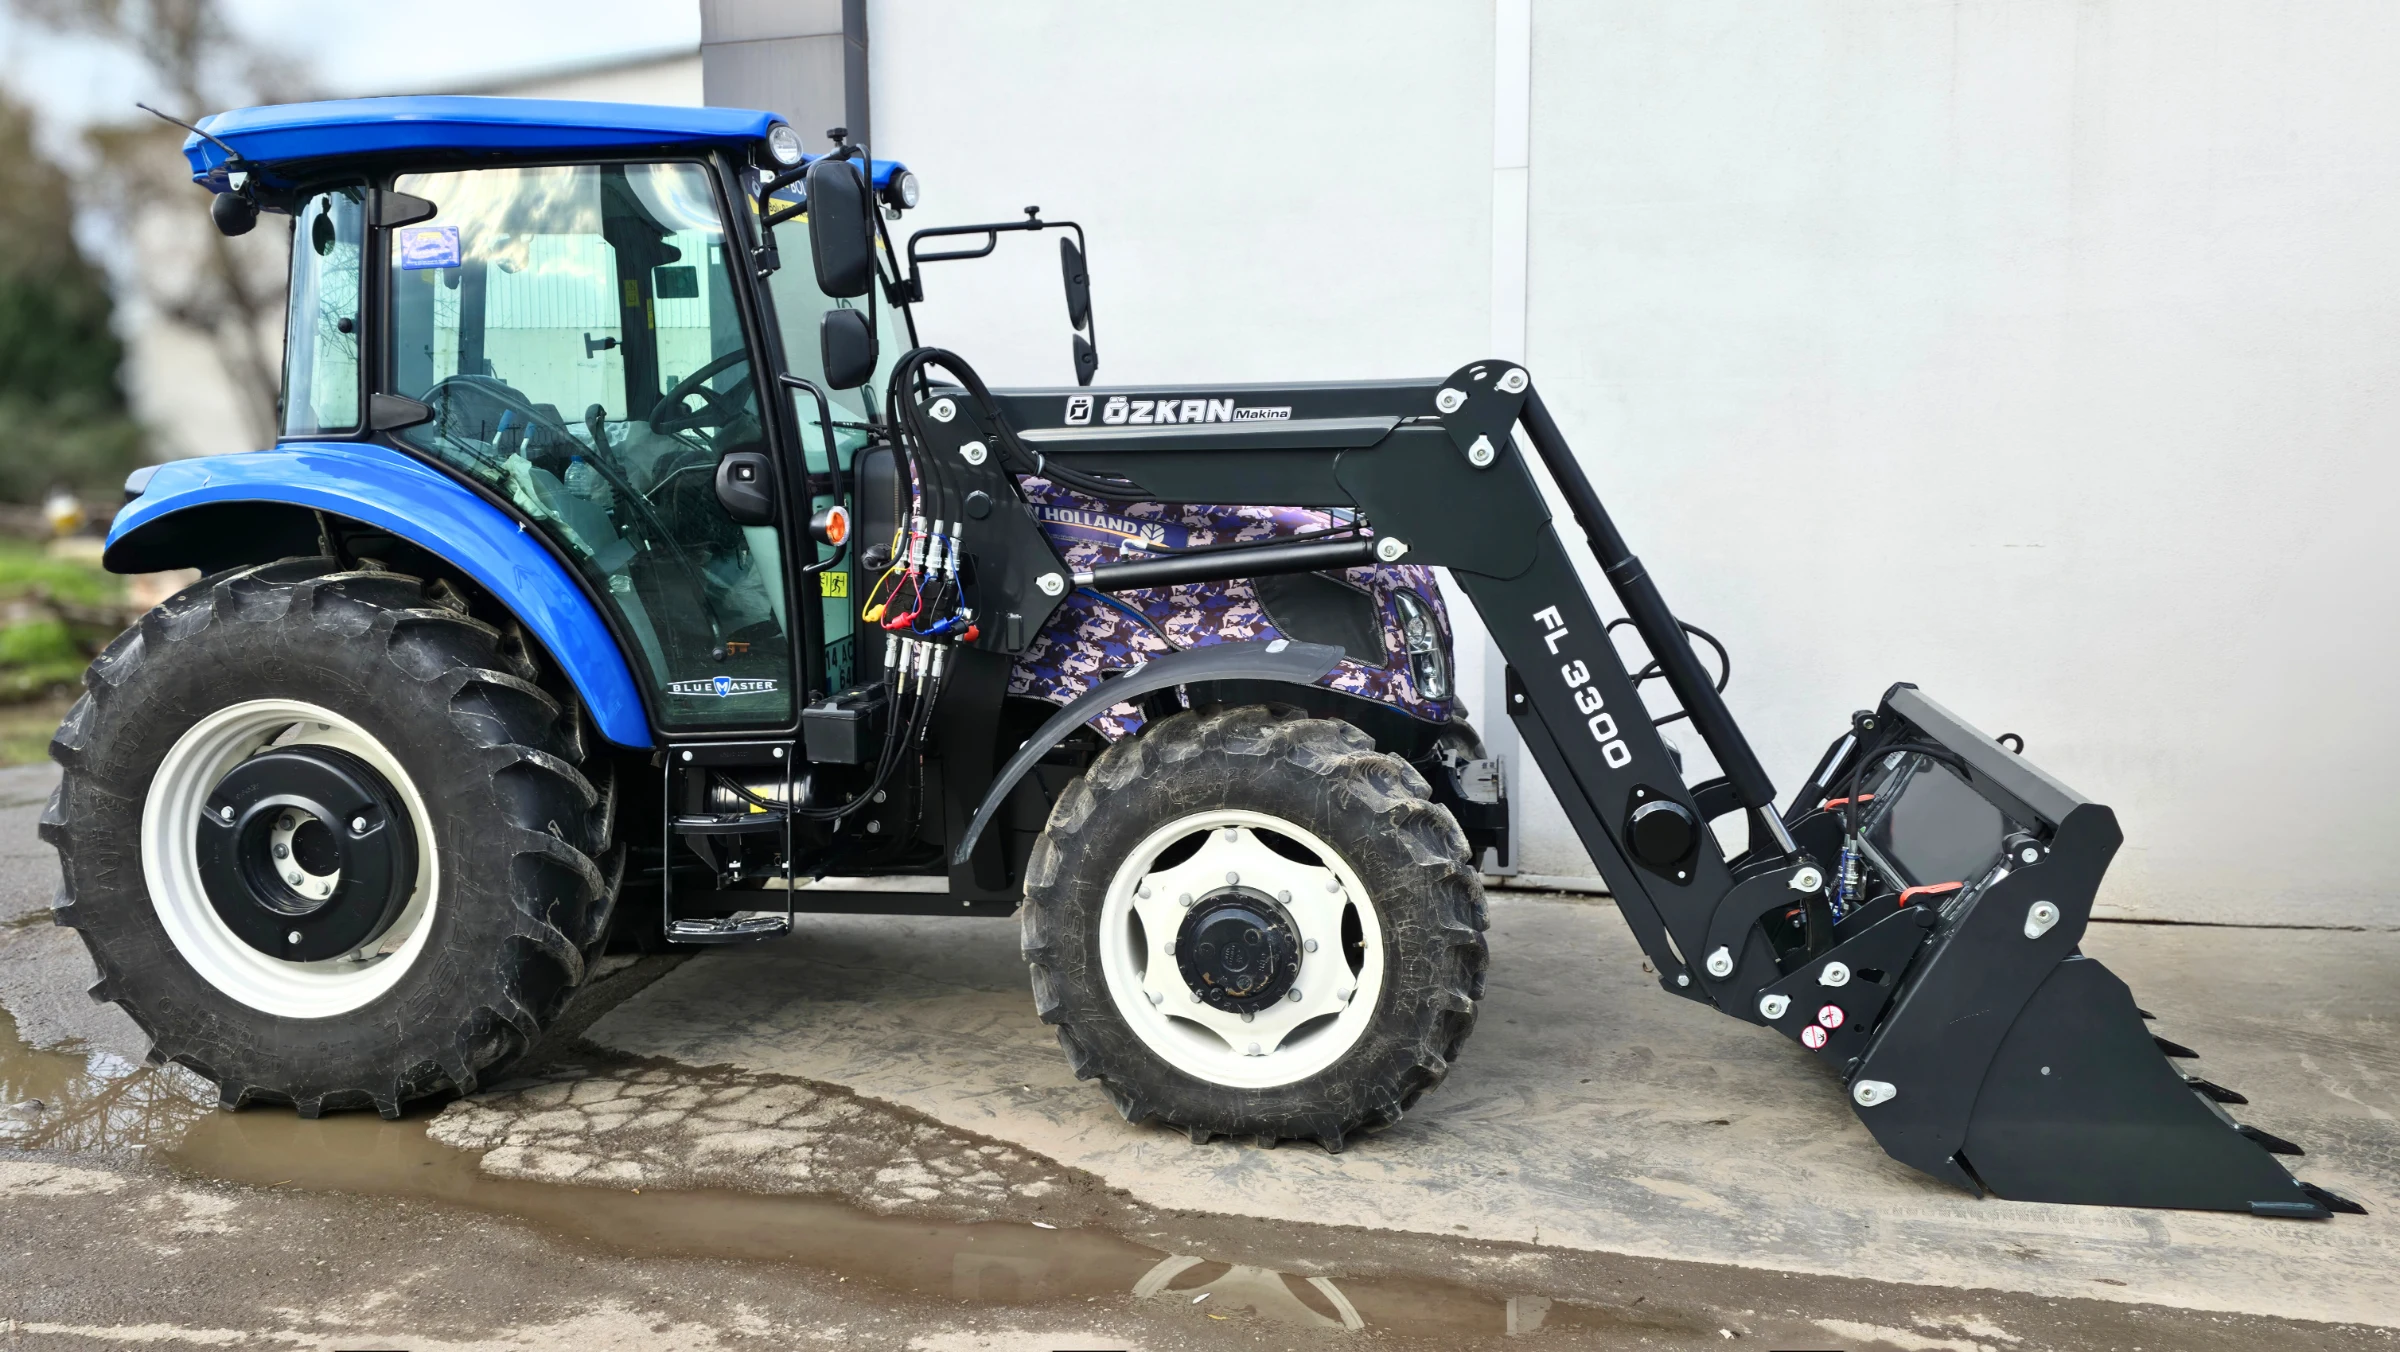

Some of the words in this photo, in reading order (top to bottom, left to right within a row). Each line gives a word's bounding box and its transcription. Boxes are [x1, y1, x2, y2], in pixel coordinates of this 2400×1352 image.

[1103, 396, 1235, 425] ÖZKAN
[1234, 408, 1290, 420] Makina
[1044, 507, 1138, 535] HOLLAND
[1532, 605, 1569, 656] FL
[1561, 659, 1632, 769] 3300
